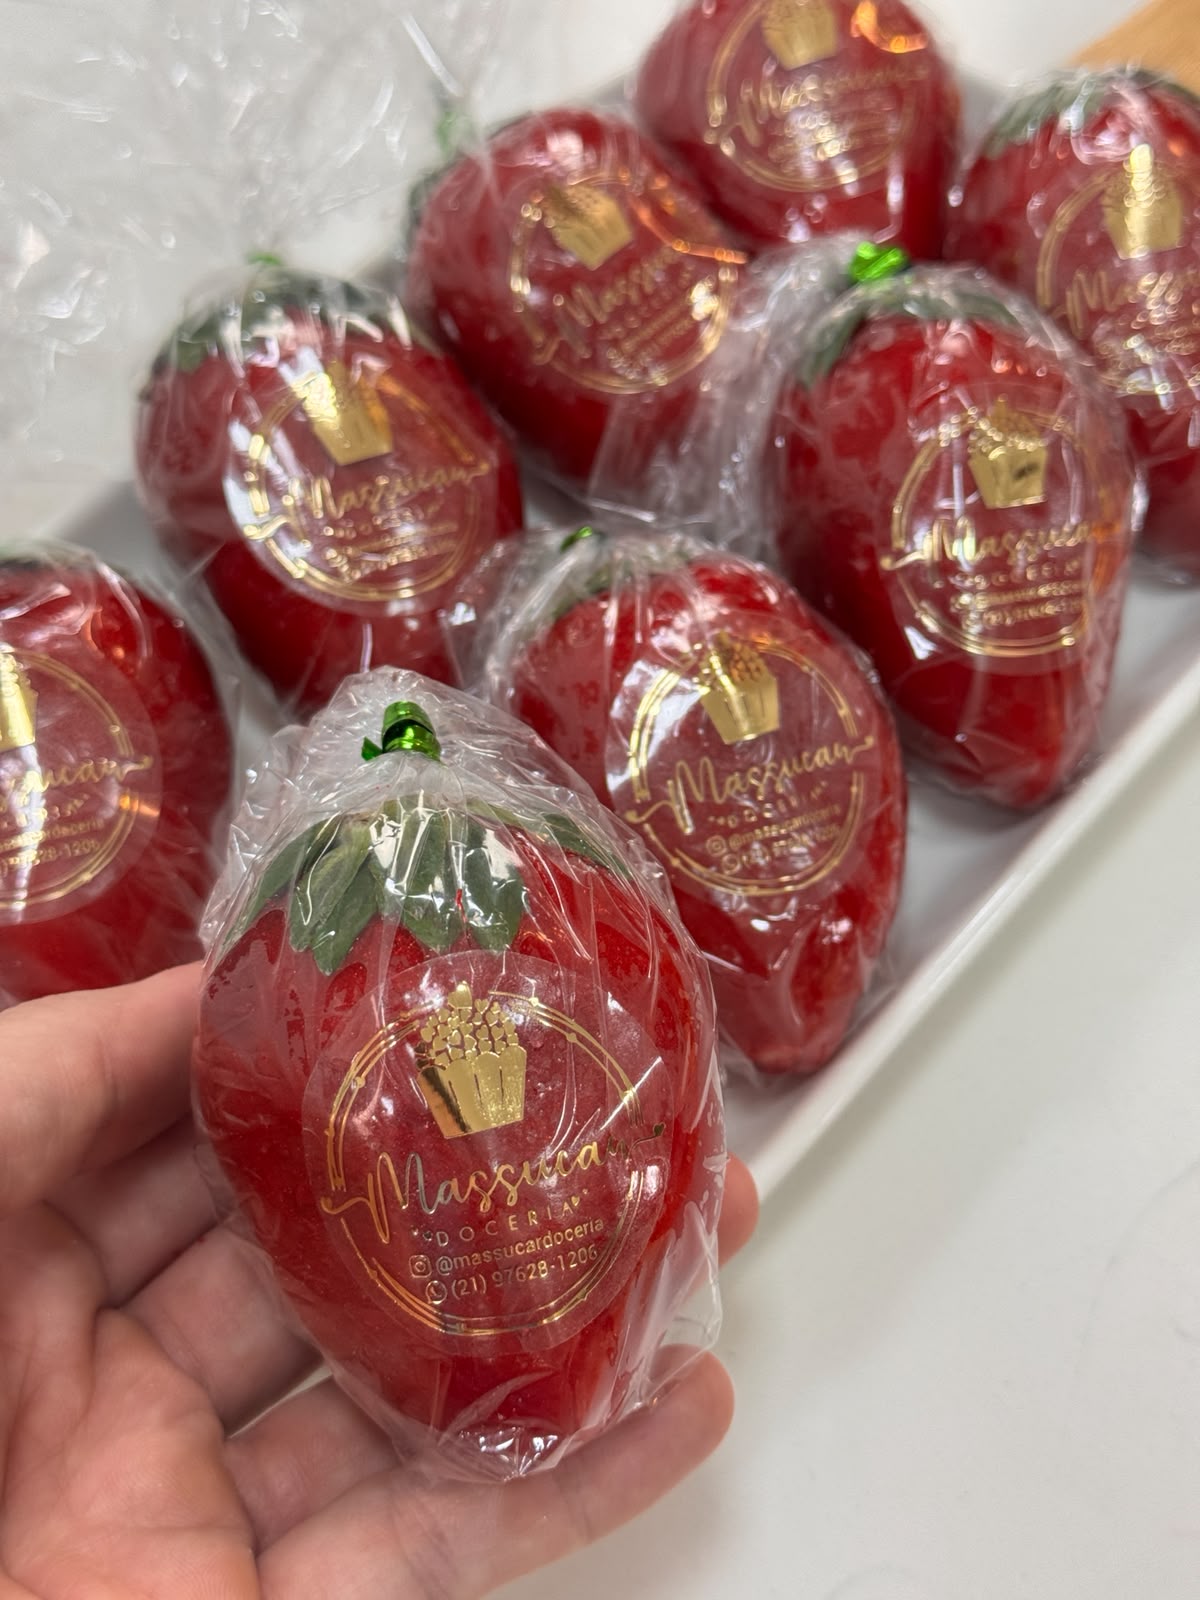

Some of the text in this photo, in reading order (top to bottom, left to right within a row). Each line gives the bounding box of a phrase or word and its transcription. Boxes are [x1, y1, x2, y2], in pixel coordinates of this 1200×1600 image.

[625, 736, 874, 836] Massucar
[320, 1122, 666, 1244] Massucar
[436, 1201, 573, 1247] DOCERIA
[436, 1217, 604, 1275] @massucardoceria
[451, 1243, 598, 1300] (21) 97628-1206
